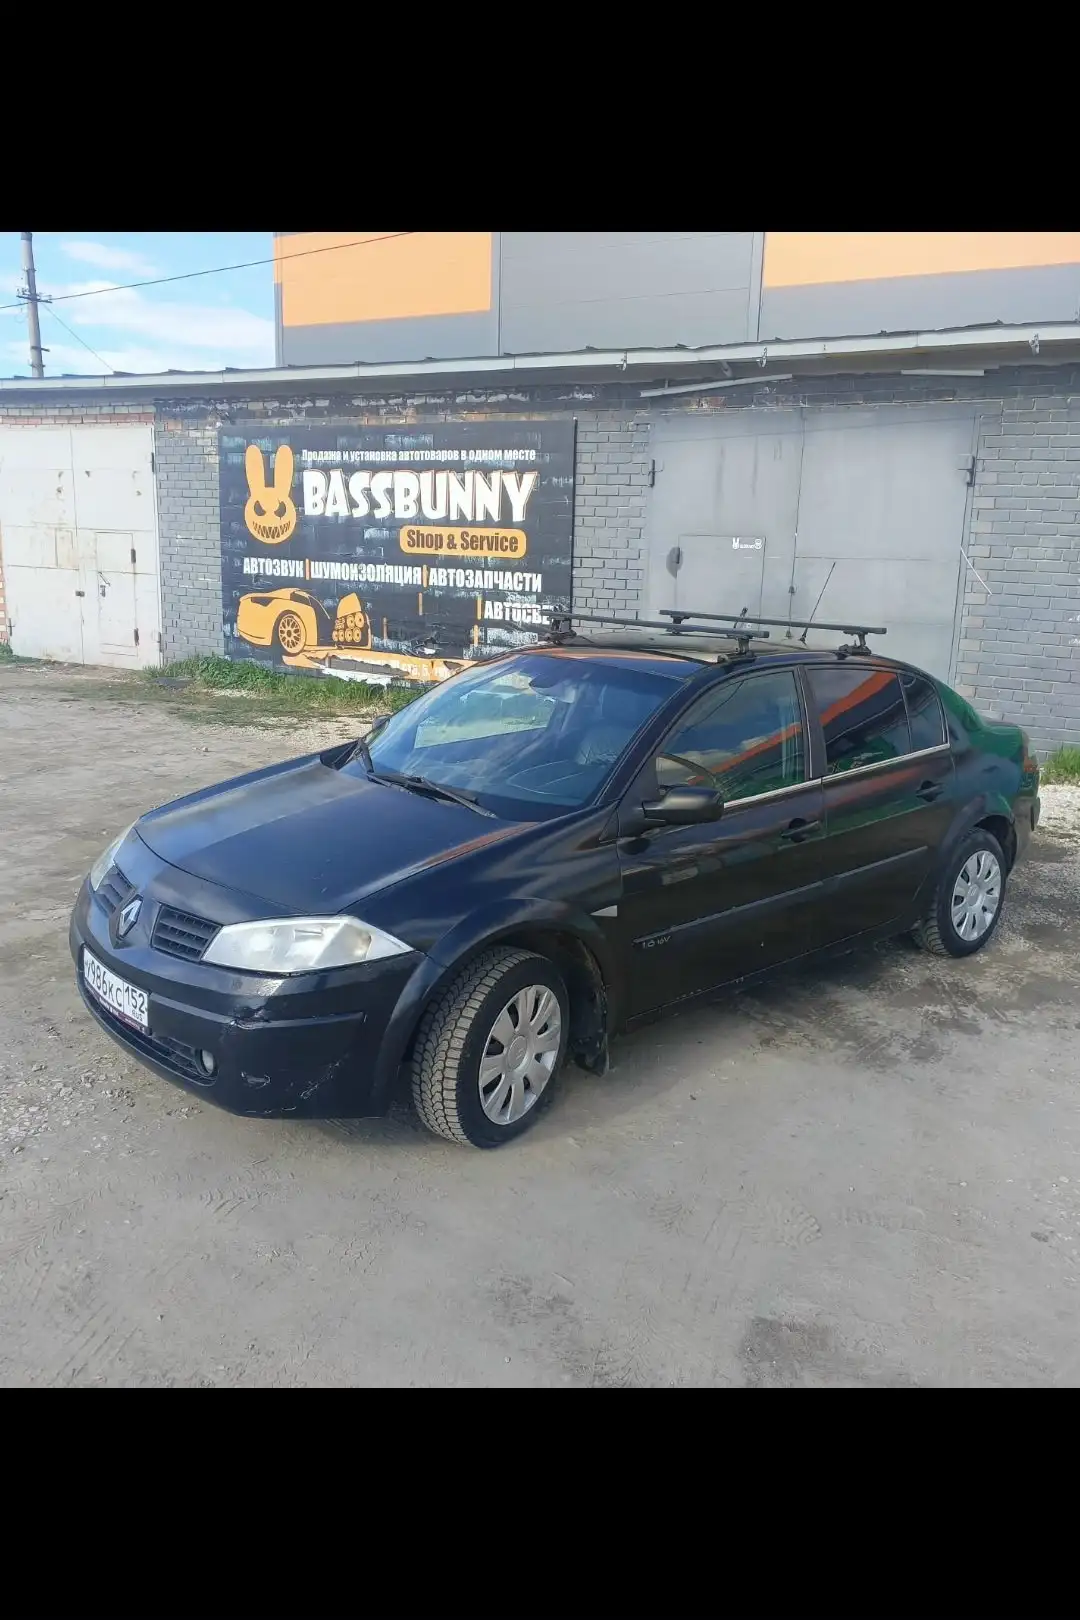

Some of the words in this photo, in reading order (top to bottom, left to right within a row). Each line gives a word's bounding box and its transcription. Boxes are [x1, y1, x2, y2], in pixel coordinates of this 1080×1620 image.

[302, 449, 342, 463] Продажа
[343, 450, 349, 461] и
[350, 450, 397, 462] установка
[398, 450, 459, 462] автотоваров
[460, 449, 467, 461] в
[468, 449, 502, 462] одном
[504, 449, 536, 461] месте
[302, 468, 538, 522] BASSBUNNY
[406, 529, 444, 551] Shop
[446, 532, 458, 550] &
[460, 532, 519, 553] Service
[243, 557, 304, 578] АВТОЗВУК
[310, 561, 422, 587] ШУМОИЗОЛЯЦИЯ
[429, 567, 542, 593] АВТОЗАПЧАСТИ
[124, 986, 146, 1015] 152
